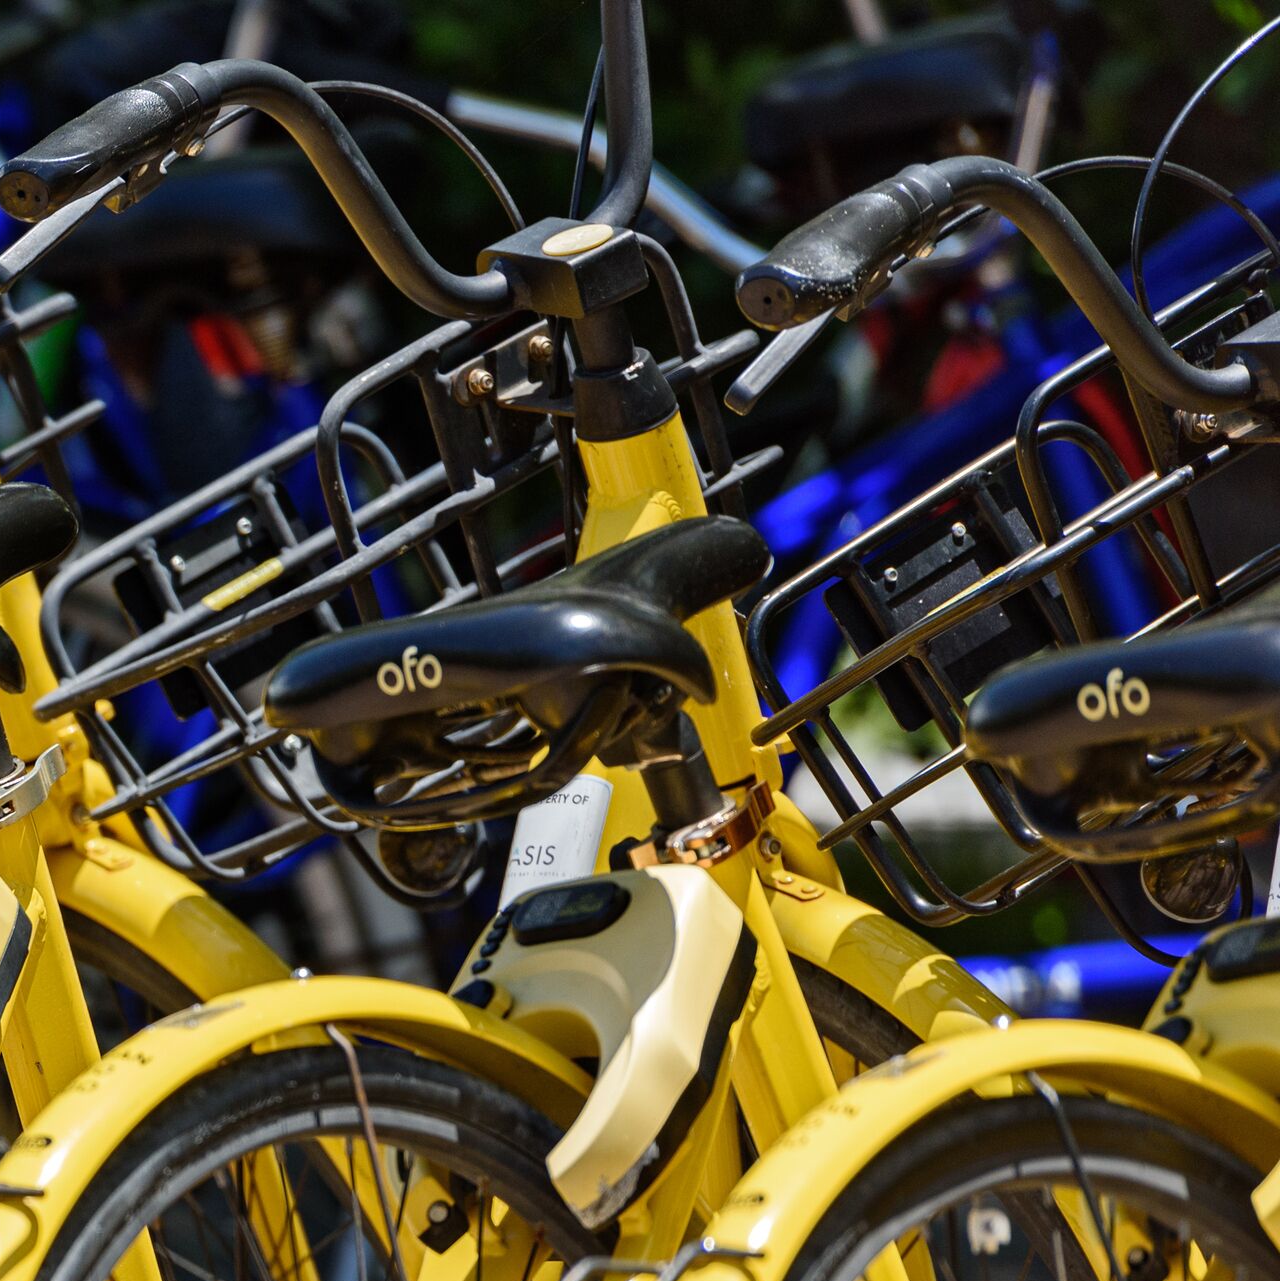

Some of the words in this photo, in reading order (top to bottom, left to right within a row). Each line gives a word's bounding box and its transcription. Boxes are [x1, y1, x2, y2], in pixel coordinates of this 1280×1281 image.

[376, 645, 443, 696] ofo
[1077, 667, 1151, 721] ofo
[571, 794, 590, 806] OF
[510, 845, 557, 866] ASIS
